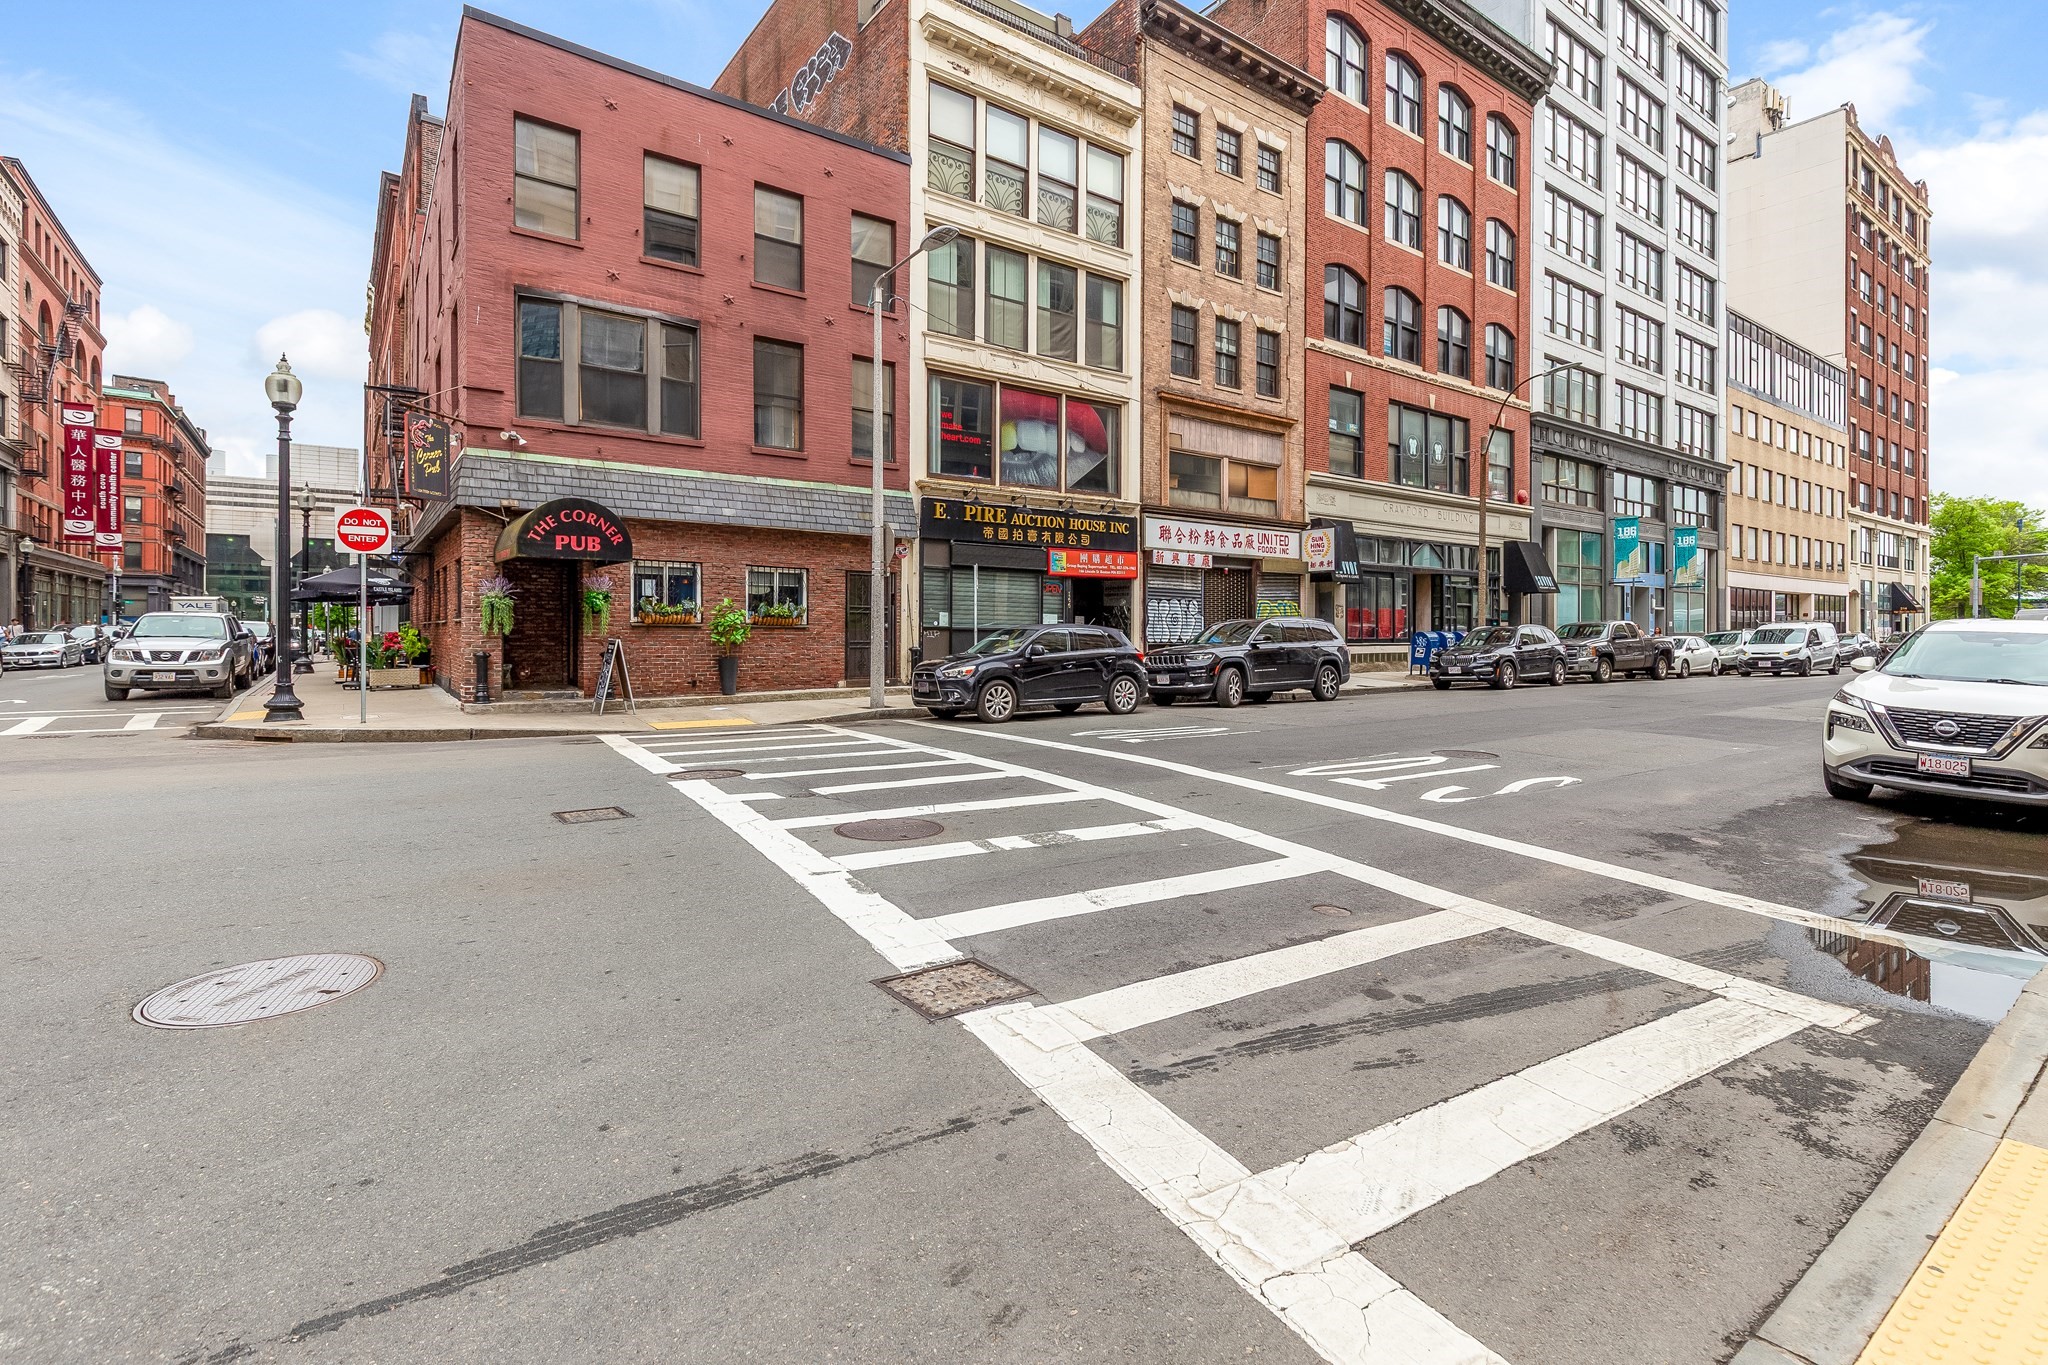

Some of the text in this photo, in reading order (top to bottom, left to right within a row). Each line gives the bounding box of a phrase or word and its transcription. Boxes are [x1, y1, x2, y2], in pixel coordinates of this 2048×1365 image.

[941, 411, 953, 419] we
[941, 422, 963, 430] make
[941, 432, 981, 444] heart.com
[416, 448, 442, 464] Corner
[70, 429, 87, 517] 華人醫務中心
[423, 460, 440, 477] Pub
[109, 452, 118, 530] community health center
[1382, 503, 1473, 524] CRAWFORD BUILDING
[362, 519, 381, 527] NOT
[527, 509, 623, 545] THE CORNER
[1010, 513, 1065, 528] AUCTION
[1069, 518, 1107, 532] HOUSE
[1109, 521, 1130, 534] INC
[348, 535, 378, 543] ENTER
[555, 535, 601, 551] PUB
[983, 526, 1090, 546] 帝國拍賣有限公司
[1257, 532, 1290, 546] UNITED
